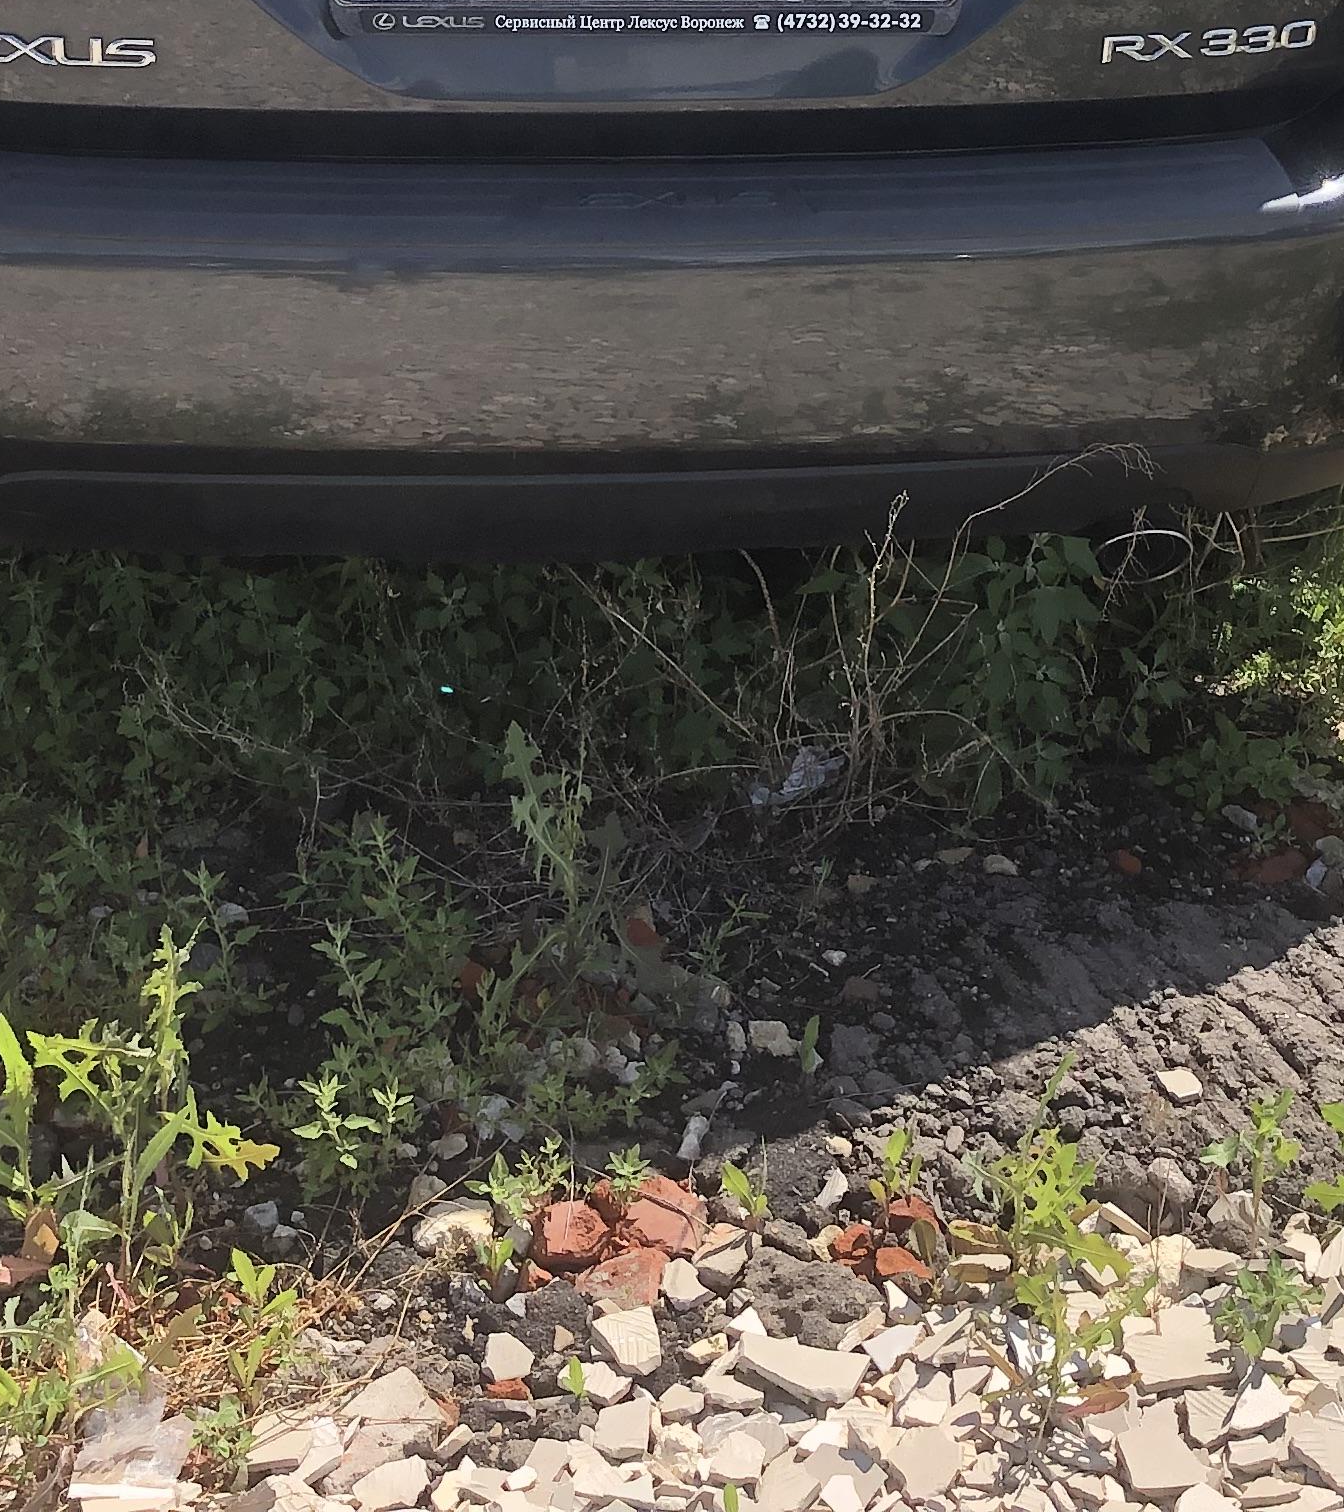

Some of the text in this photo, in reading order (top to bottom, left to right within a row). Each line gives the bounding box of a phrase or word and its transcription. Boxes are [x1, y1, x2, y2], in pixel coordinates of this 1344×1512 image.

[402, 16, 486, 29] LEXUS
[495, 14, 576, 31] Сервисный
[579, 15, 624, 31] Центр
[627, 15, 678, 32] Лексус
[680, 15, 745, 31] Воронеж
[776, 13, 836, 32] (4732)
[838, 13, 922, 30] 39-32-32
[1101, 20, 1316, 64] RX 330
